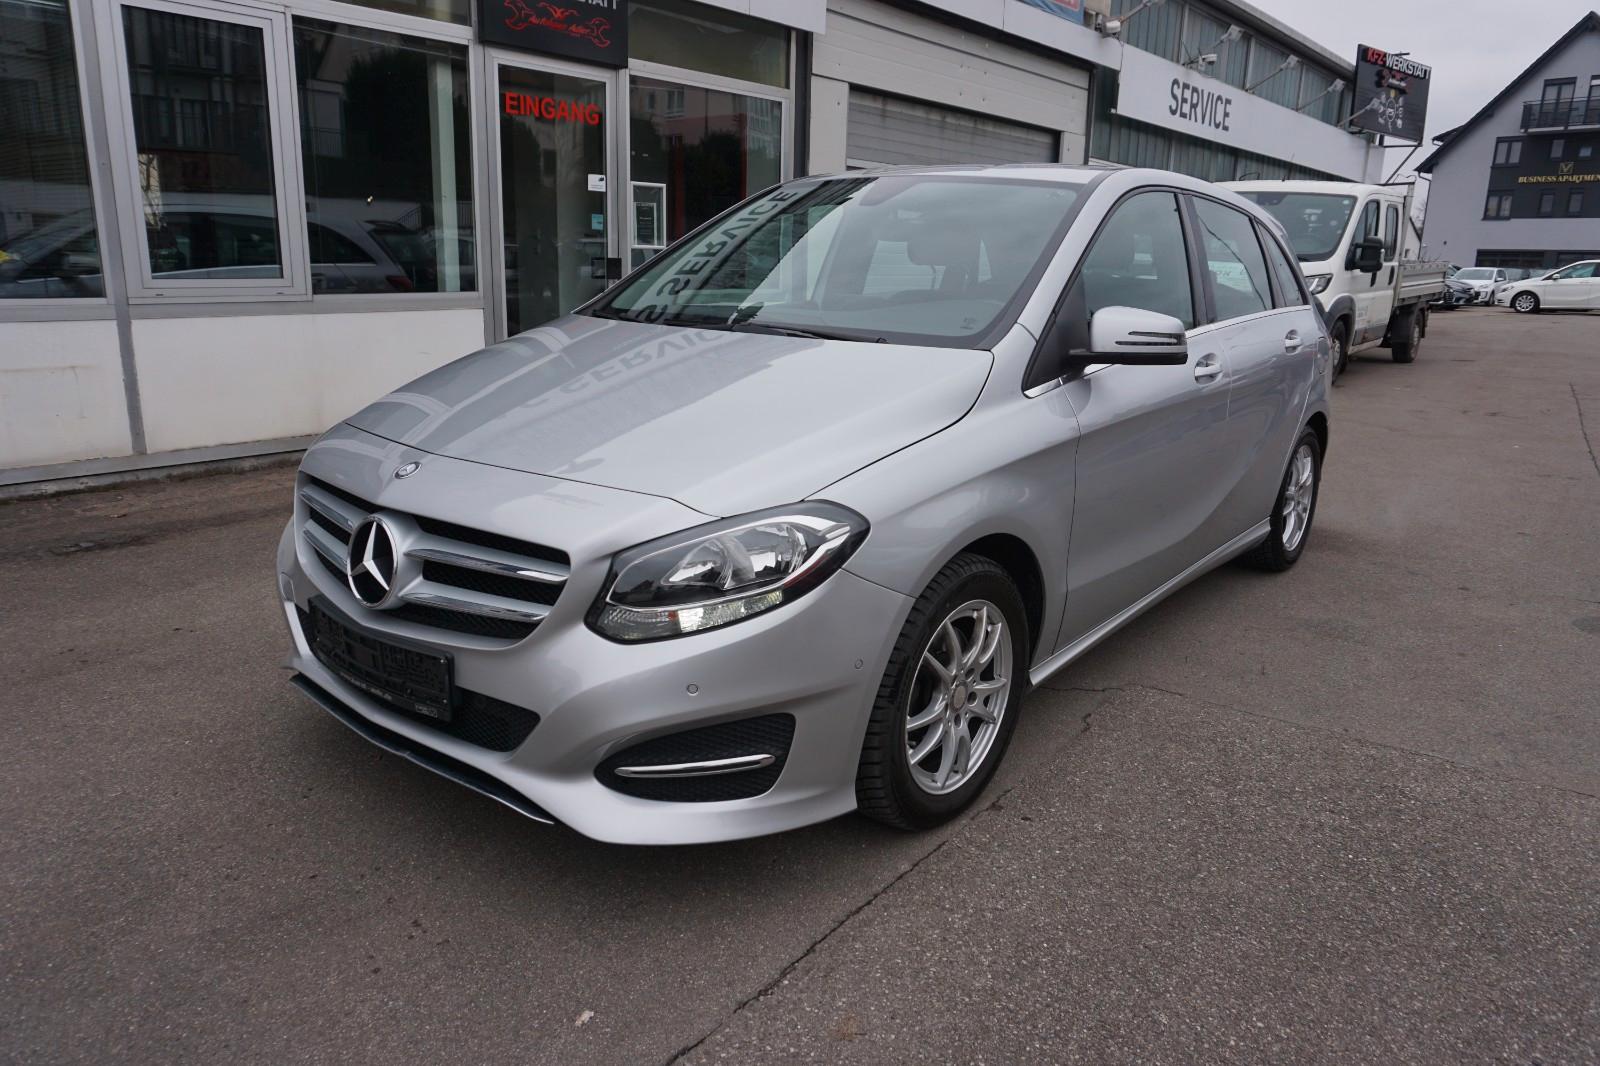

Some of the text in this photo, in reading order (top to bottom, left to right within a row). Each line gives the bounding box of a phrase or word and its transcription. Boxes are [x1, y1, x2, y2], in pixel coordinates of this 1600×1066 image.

[505, 91, 601, 126] EINGANG
[1169, 78, 1232, 131] SERVICE
[1517, 175, 1557, 184] BUSINESS
